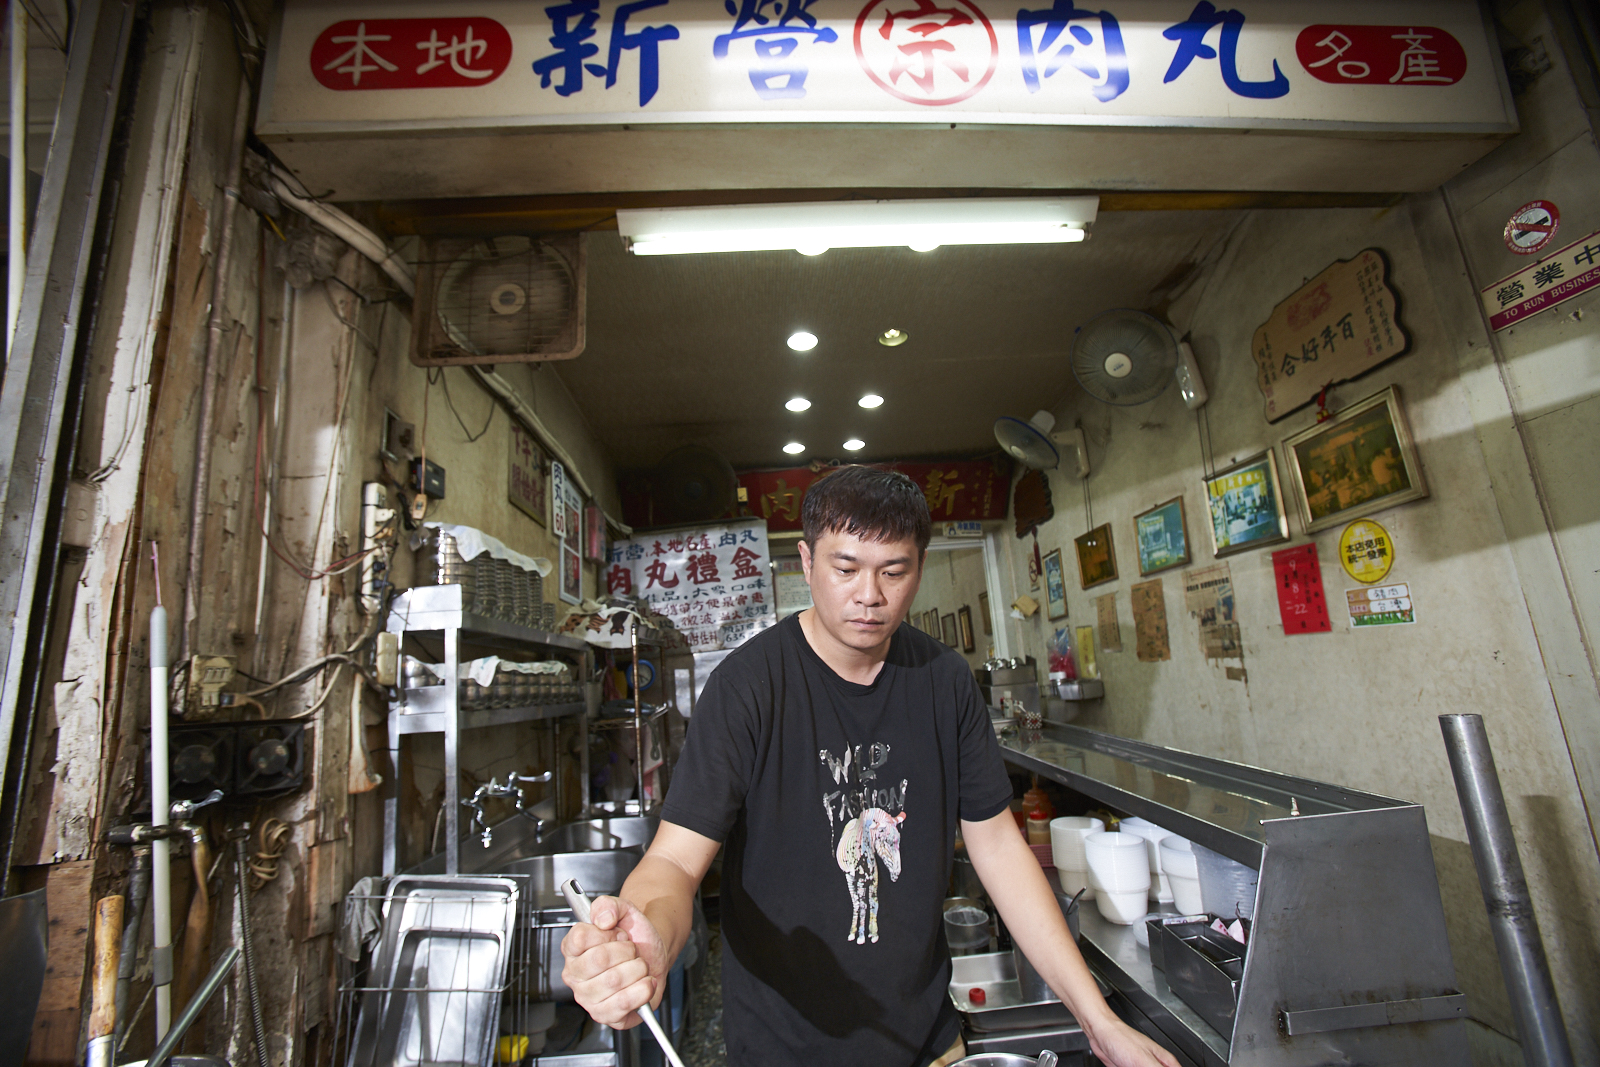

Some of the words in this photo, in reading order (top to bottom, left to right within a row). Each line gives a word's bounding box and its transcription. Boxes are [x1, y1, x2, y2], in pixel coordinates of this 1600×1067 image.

[323, 22, 494, 86] 本地
[1016, 0, 1291, 102] 肉丸
[1309, 27, 1455, 84] 名產
[1496, 245, 1600, 309] 營業中
[1503, 307, 1518, 320] TO
[1523, 295, 1546, 311] RUN
[760, 477, 802, 522] 肉
[1345, 536, 1386, 554] 本店免用
[1347, 547, 1389, 564] 統一發票
[607, 546, 763, 596] 肉丸禮盒
[819, 740, 891, 785] WLD
